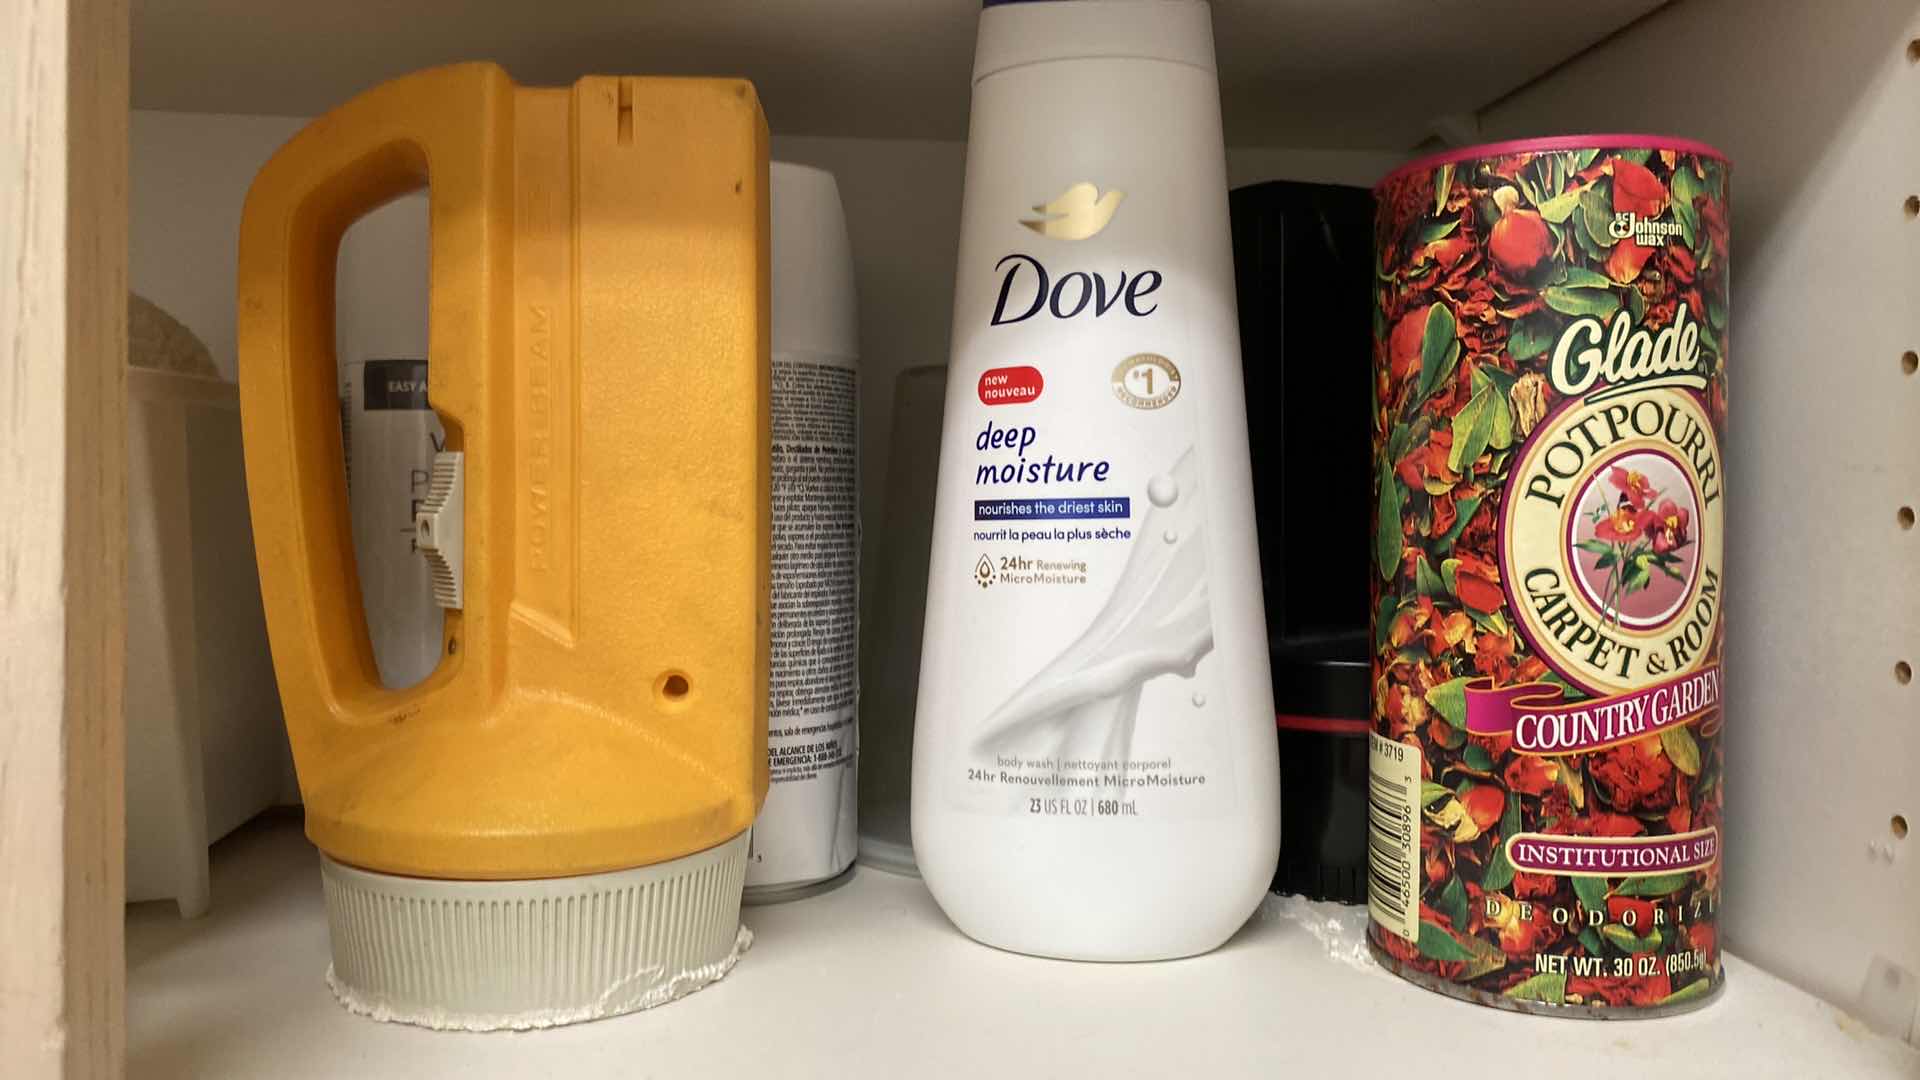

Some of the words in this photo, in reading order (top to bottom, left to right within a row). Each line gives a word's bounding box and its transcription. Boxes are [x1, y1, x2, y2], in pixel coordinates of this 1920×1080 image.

[1609, 212, 1683, 239] Johnson
[1636, 235, 1665, 247] wax
[990, 254, 1162, 326] Dove
[1551, 302, 1700, 396] Glade
[388, 380, 416, 393] EASY
[984, 374, 1008, 386] new
[984, 385, 1036, 399] nouveau
[976, 420, 1036, 457] deep
[1525, 400, 1720, 510] POTPOURRI
[976, 455, 1110, 485] moisture
[979, 502, 1032, 515] nourishes
[1035, 502, 1055, 514] the
[1058, 501, 1095, 514] driest
[1098, 500, 1123, 513] skin
[973, 528, 1008, 541] nourrit
[1009, 528, 1020, 541] la
[1021, 531, 1051, 543] peau
[1053, 528, 1065, 540] la
[1067, 528, 1092, 542] plus
[1095, 527, 1131, 540] sèche
[1000, 555, 1034, 571] 24hr
[1036, 559, 1087, 572] Renewing
[1000, 572, 1087, 585] MicroMoisture
[1524, 567, 1641, 680] CARPET
[1645, 652, 1670, 676] &
[1665, 566, 1719, 669] ROOM
[1515, 694, 1649, 750] COUNTRY
[1650, 669, 1720, 726] GARDEN
[996, 755, 1024, 769] body
[1026, 757, 1053, 769] wash
[1063, 758, 1119, 771] nettoyant
[1123, 757, 1172, 770] corporel
[1384, 743, 1404, 763] 3719
[968, 768, 997, 783] 24hr
[1000, 771, 1100, 787] Renouvellement
[1103, 774, 1206, 788] MicroMoisture
[1029, 798, 1042, 815] 23
[1044, 799, 1058, 815] US
[1060, 799, 1071, 815] FL
[1074, 799, 1088, 816] OZ
[1097, 799, 1119, 816] 680
[1121, 799, 1138, 816] mL
[1401, 805, 1411, 851] 30896
[1518, 842, 1691, 868] INSTITUTIONAL
[1693, 836, 1716, 861] SIZE
[1535, 953, 1568, 975] NET
[1573, 956, 1608, 978] WT.
[1613, 956, 1633, 977] 30
[1637, 955, 1661, 977] OZ.
